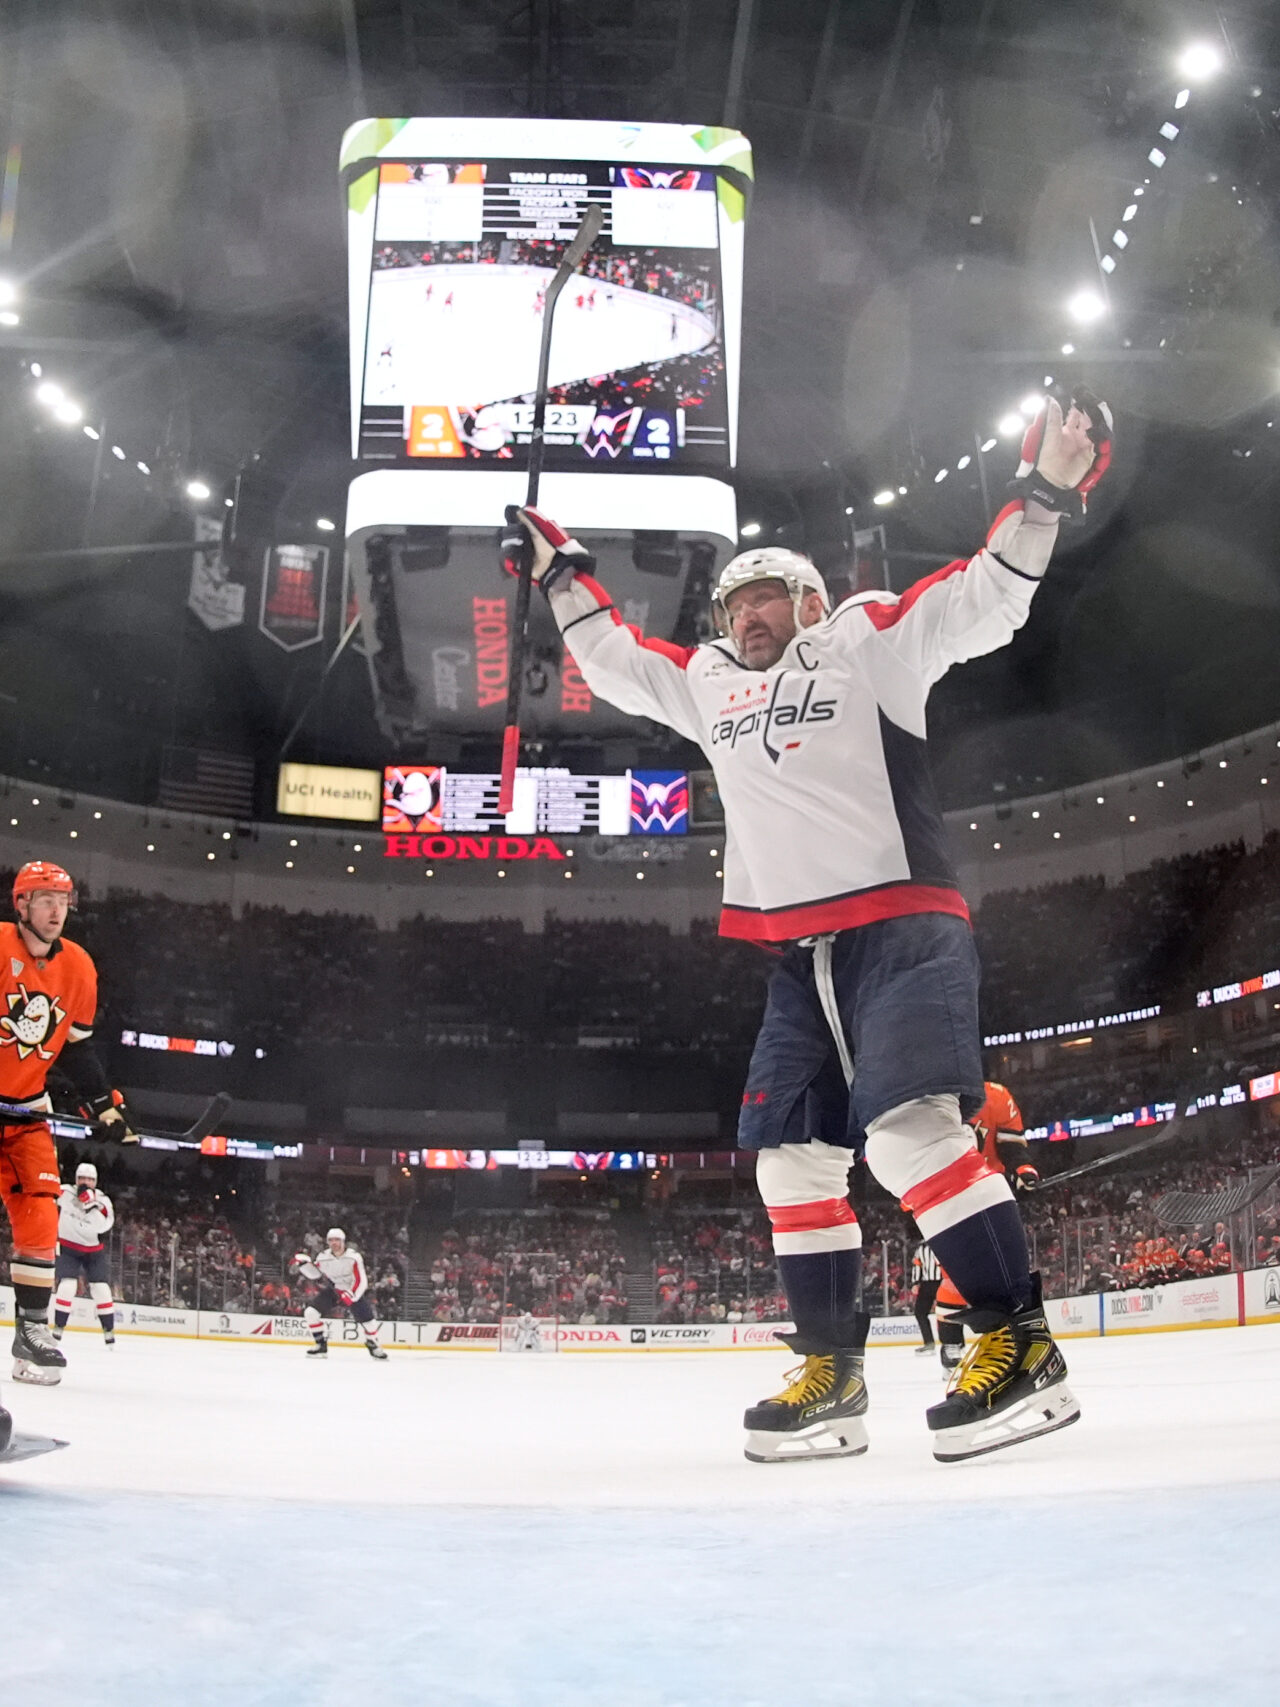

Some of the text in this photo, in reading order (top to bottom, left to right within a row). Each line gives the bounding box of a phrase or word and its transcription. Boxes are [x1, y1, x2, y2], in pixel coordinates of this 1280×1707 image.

[422, 414, 444, 439] 2
[646, 418, 670, 444] 2
[473, 596, 509, 709] HONDA
[796, 641, 819, 671] C
[286, 783, 373, 801] UCI Health
[384, 836, 565, 861] HONDA
[984, 1004, 1161, 1047] SCORE YOUR DREAM APARTMENT
[435, 1151, 447, 1166] 2
[620, 1153, 632, 1169] 2
[651, 1328, 711, 1338] VICTORY
